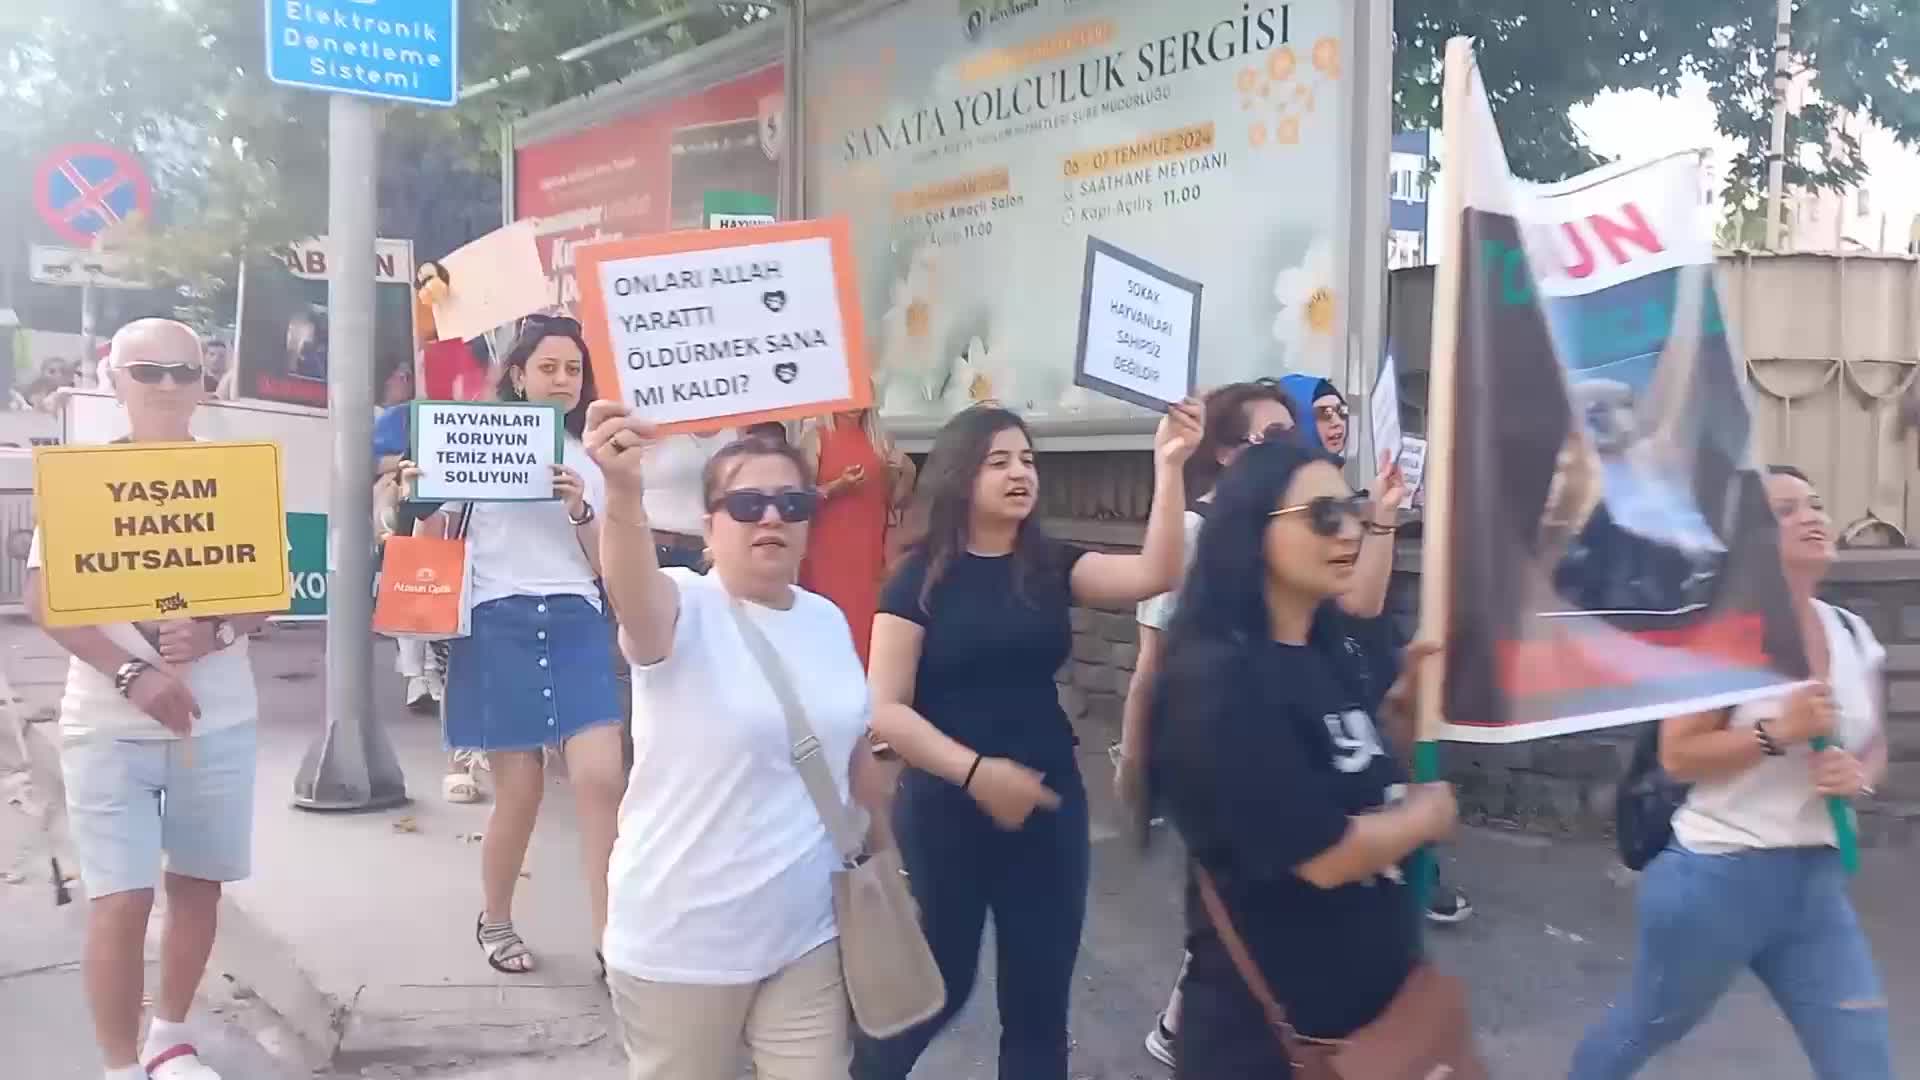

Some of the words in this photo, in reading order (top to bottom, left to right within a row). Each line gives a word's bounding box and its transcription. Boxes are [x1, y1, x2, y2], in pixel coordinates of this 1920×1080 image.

[286, 0, 438, 42] Elektronik
[284, 27, 442, 68] Denetleme
[309, 57, 419, 89] Sistemi
[844, 104, 947, 162] SANATA
[953, 50, 1126, 132] YOLCULUK
[1114, 136, 1170, 163] TEMMUZ
[1080, 169, 1153, 197] SAATHANE
[1157, 152, 1228, 181] MEYDANI
[991, 194, 1025, 211] Salon
[1163, 184, 1201, 206] 11.00
[614, 269, 704, 297] ONLARI
[710, 260, 784, 288] ALLAH
[619, 305, 715, 333] YARATTI
[627, 340, 762, 371] ÖLDÜRMEK
[765, 329, 829, 354] SANA
[634, 385, 665, 408] MI
[672, 373, 751, 404] KALDI?
[433, 412, 540, 427] HAYVANLARI
[446, 432, 528, 446] KORUYUN
[436, 449, 487, 465] TEMİZ
[492, 452, 537, 465] HAVA
[105, 477, 218, 507] YAŞAM
[444, 471, 529, 485] SOLUYUN!
[114, 511, 216, 538] HAKKI
[74, 543, 257, 575] KUTSALDIR
